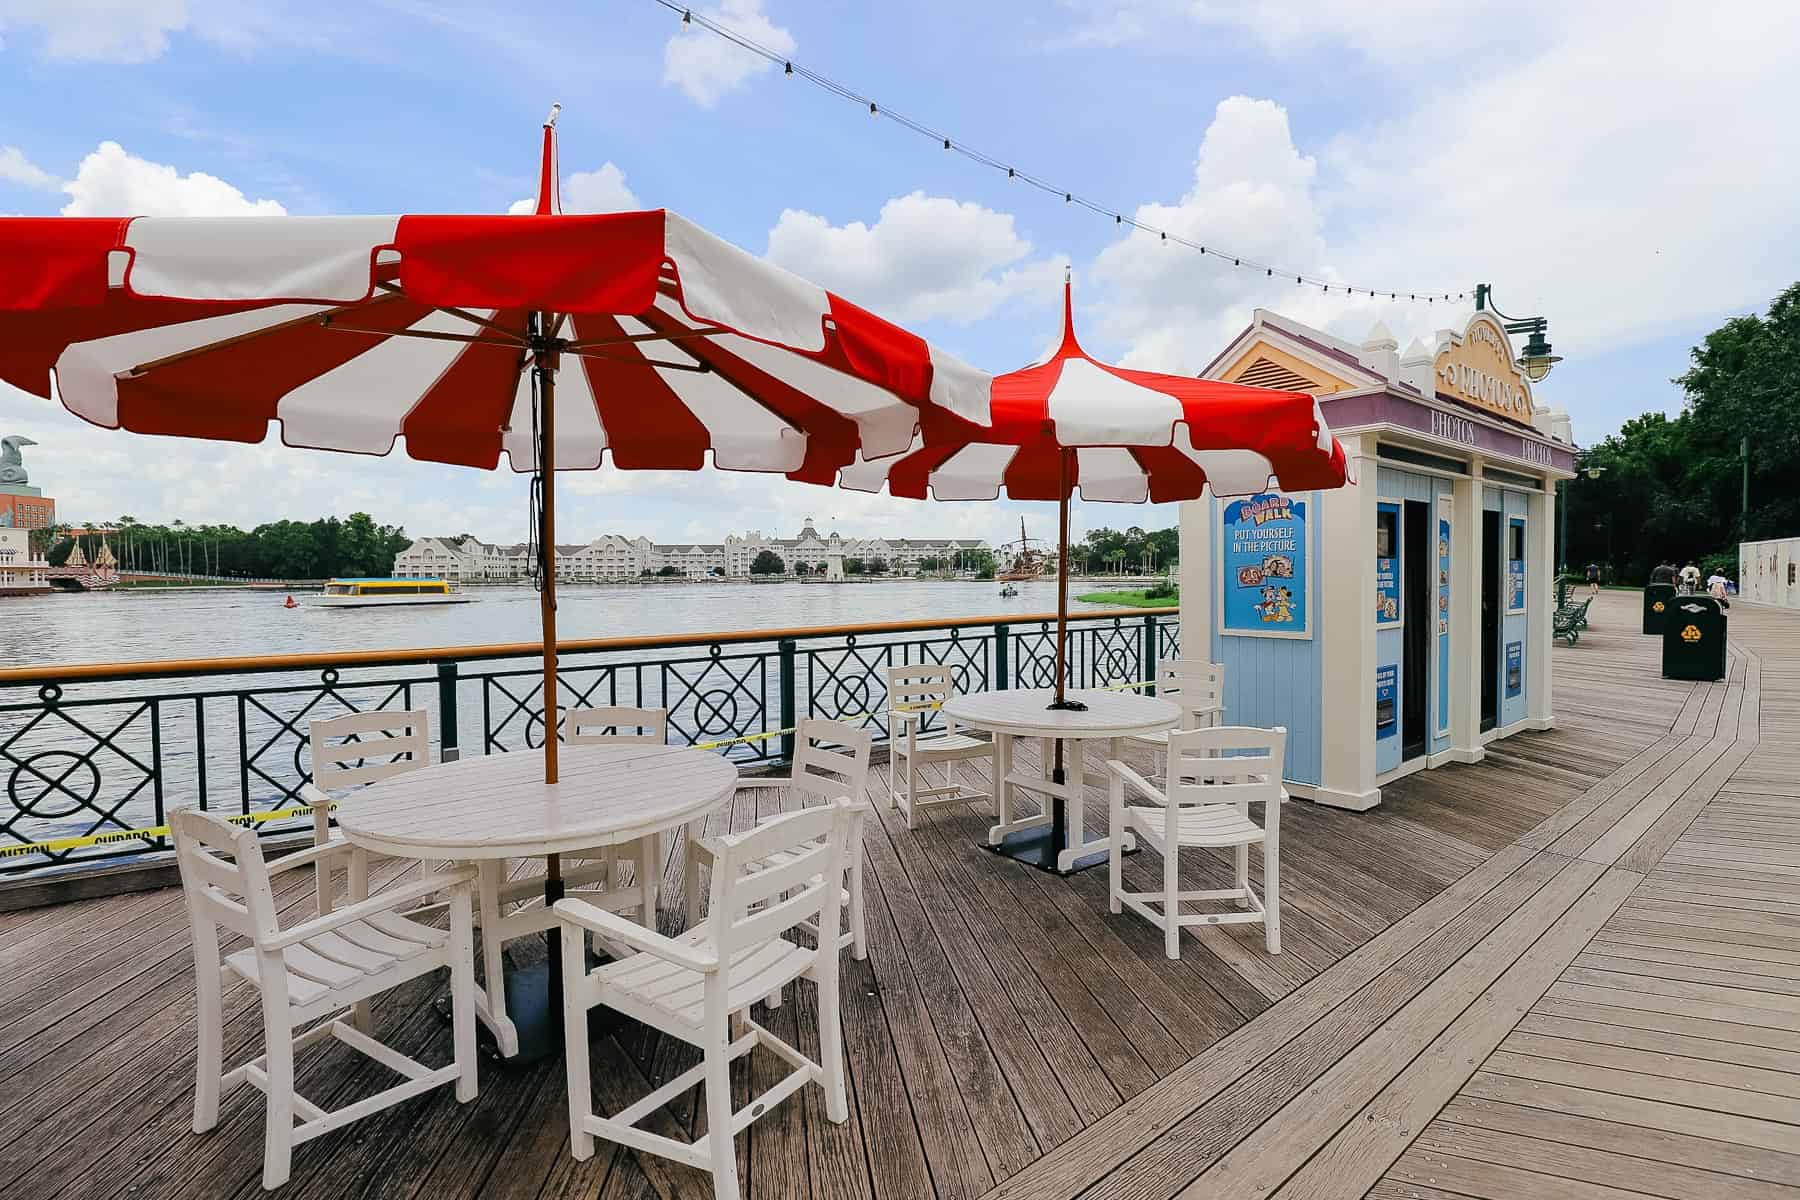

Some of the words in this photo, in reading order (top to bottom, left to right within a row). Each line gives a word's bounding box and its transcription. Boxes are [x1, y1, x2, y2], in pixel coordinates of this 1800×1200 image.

[1458, 363, 1512, 411] PHOTOS
[1431, 409, 1474, 445] PHOTOS
[1522, 439, 1552, 466] PHOTOS
[1241, 497, 1290, 520] BOARD
[1253, 507, 1294, 526] WALK
[1234, 529, 1250, 540] PUT
[1251, 527, 1295, 540] YOURSELF
[1233, 542, 1242, 553] IN
[1244, 541, 1259, 553] THE
[1260, 539, 1297, 553] PICTURE
[0, 844, 50, 858] AUTION
